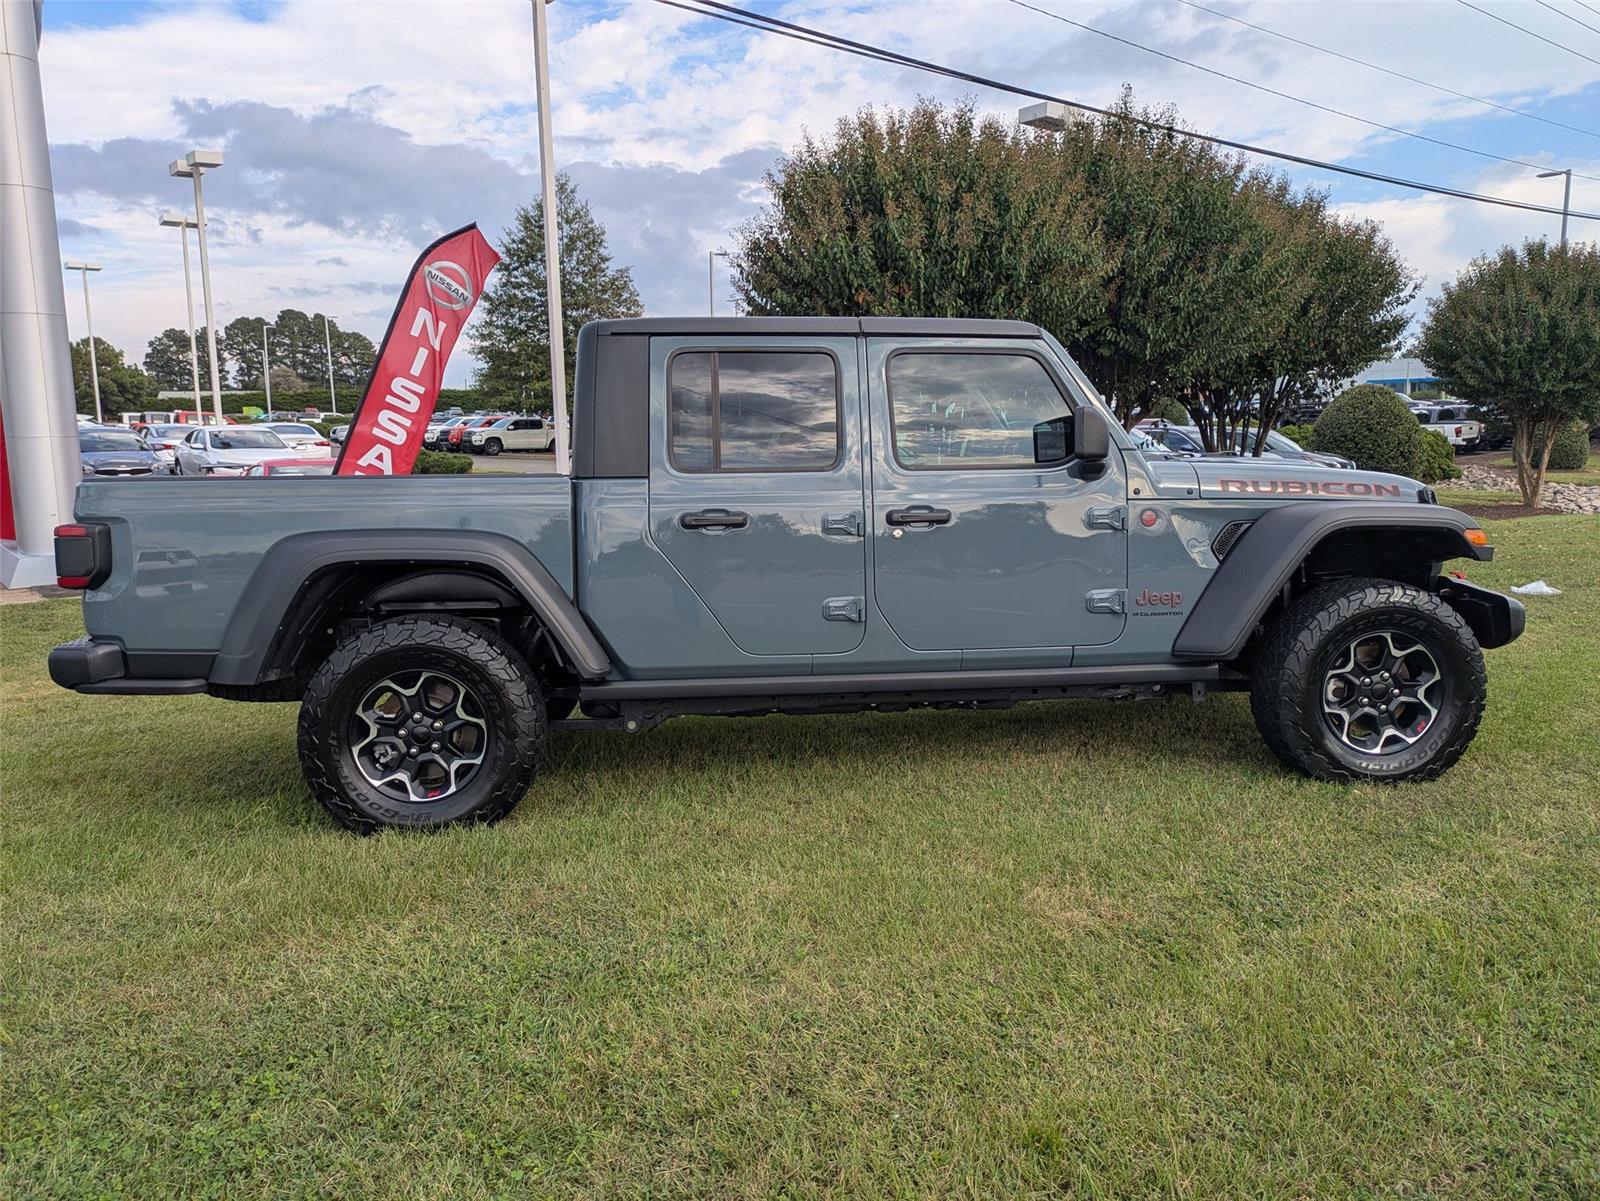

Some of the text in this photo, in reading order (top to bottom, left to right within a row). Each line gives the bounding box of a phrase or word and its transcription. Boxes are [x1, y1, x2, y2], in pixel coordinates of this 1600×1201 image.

[427, 270, 469, 302] NISSAN
[354, 307, 448, 476] NISSA
[1219, 479, 1402, 498] RUBICON
[1135, 589, 1183, 608] Jeep
